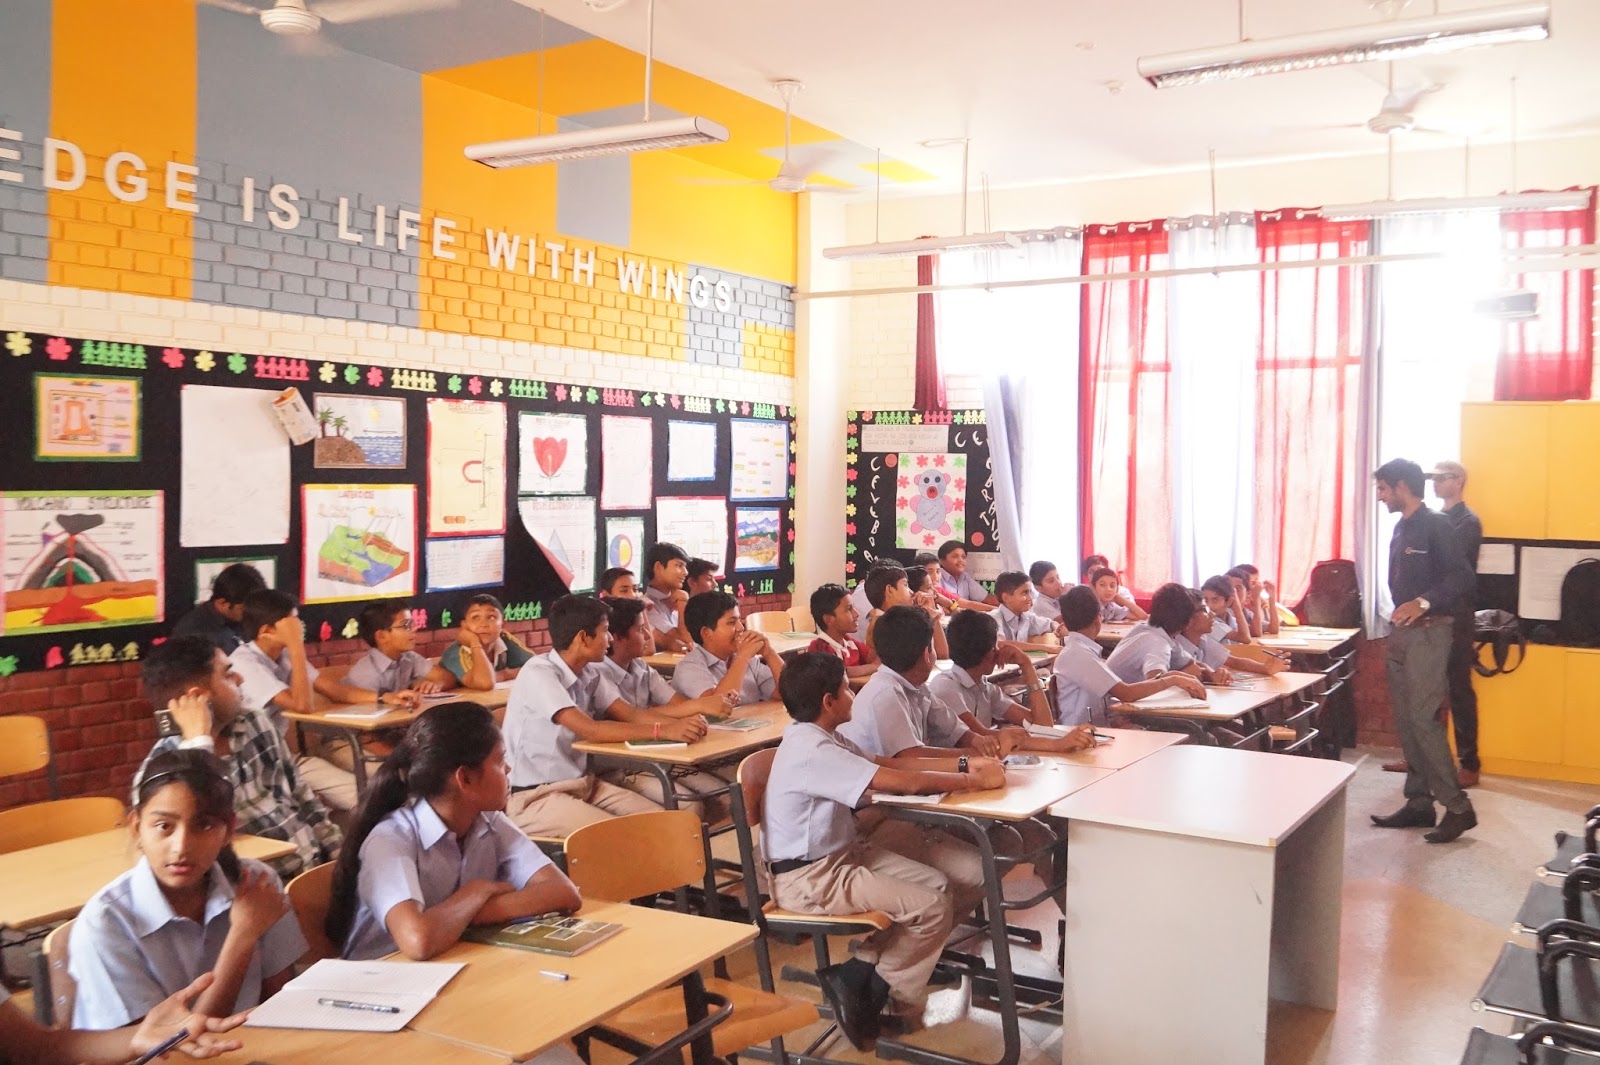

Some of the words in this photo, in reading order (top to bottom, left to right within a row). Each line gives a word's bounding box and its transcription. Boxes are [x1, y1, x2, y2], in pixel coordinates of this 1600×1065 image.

[242, 177, 300, 230] IS
[337, 197, 457, 260] LIFE
[485, 228, 595, 288] WITH
[616, 256, 731, 313] WINGS
